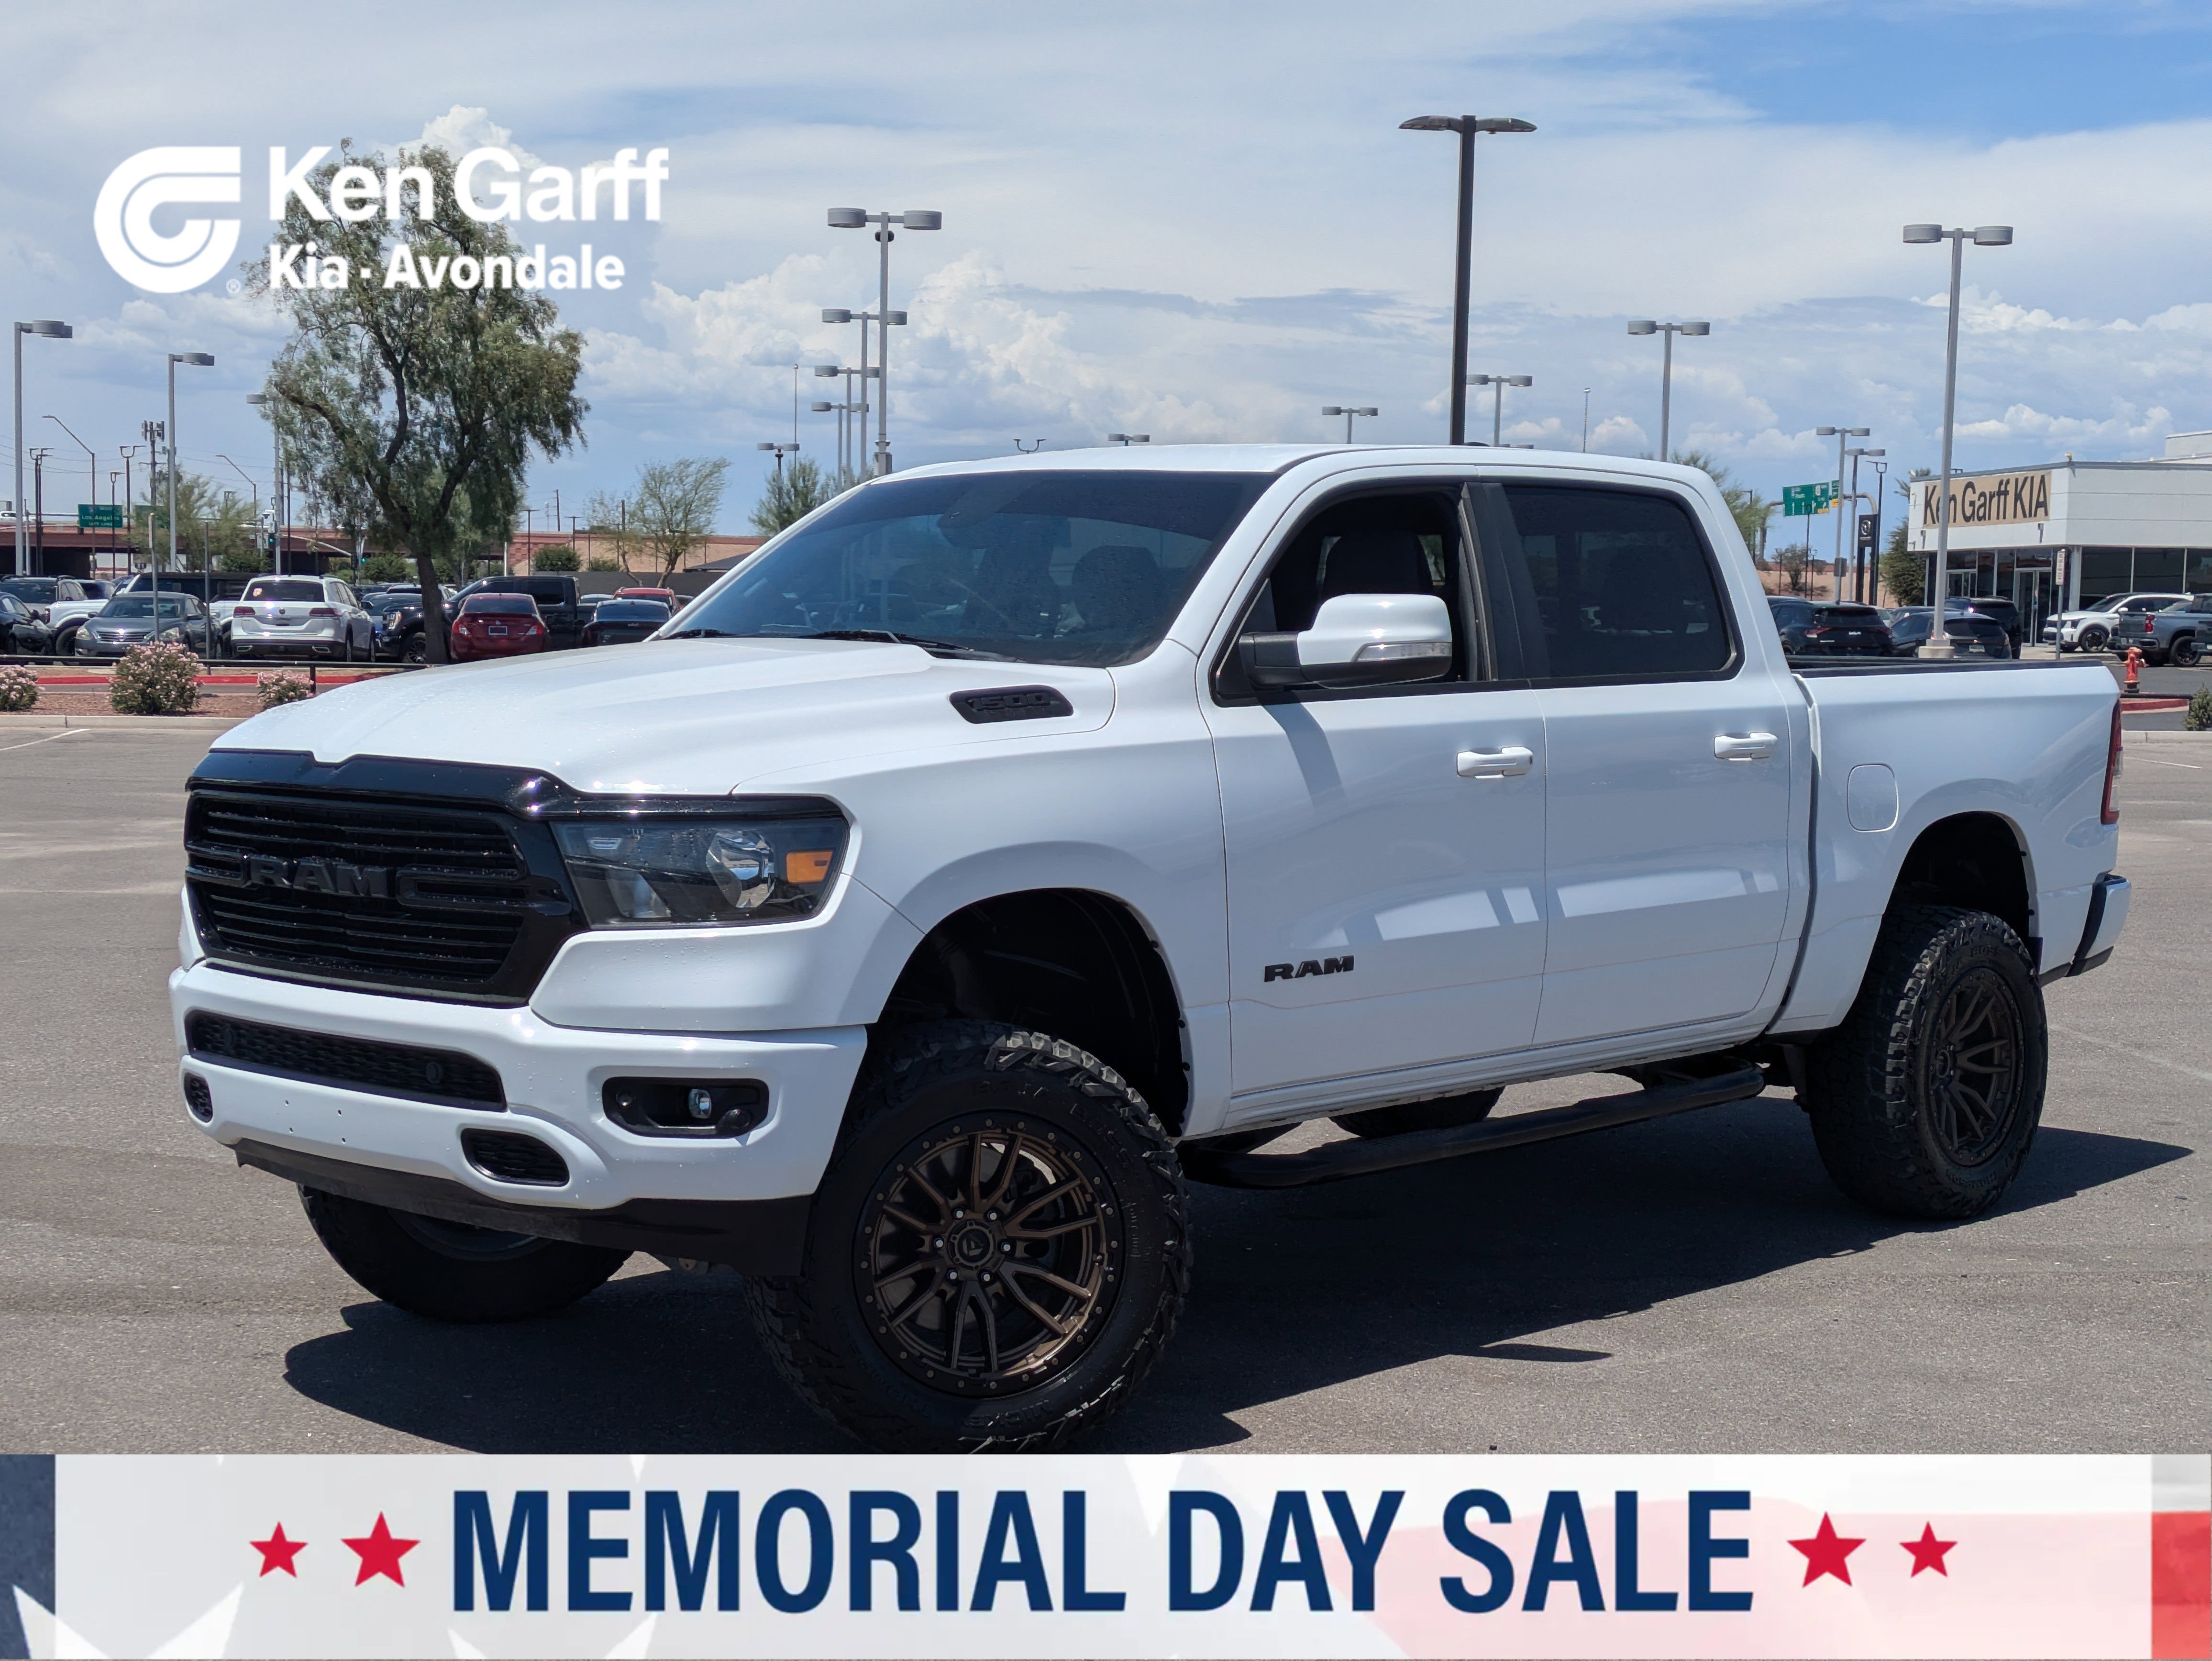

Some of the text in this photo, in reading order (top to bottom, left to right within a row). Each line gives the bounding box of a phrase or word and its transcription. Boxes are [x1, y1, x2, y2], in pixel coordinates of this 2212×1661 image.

[1924, 475, 2048, 524] Kn Garff KIA
[965, 693, 1053, 711] 1500
[249, 855, 389, 899] RAM
[1264, 955, 1354, 983] RAM
